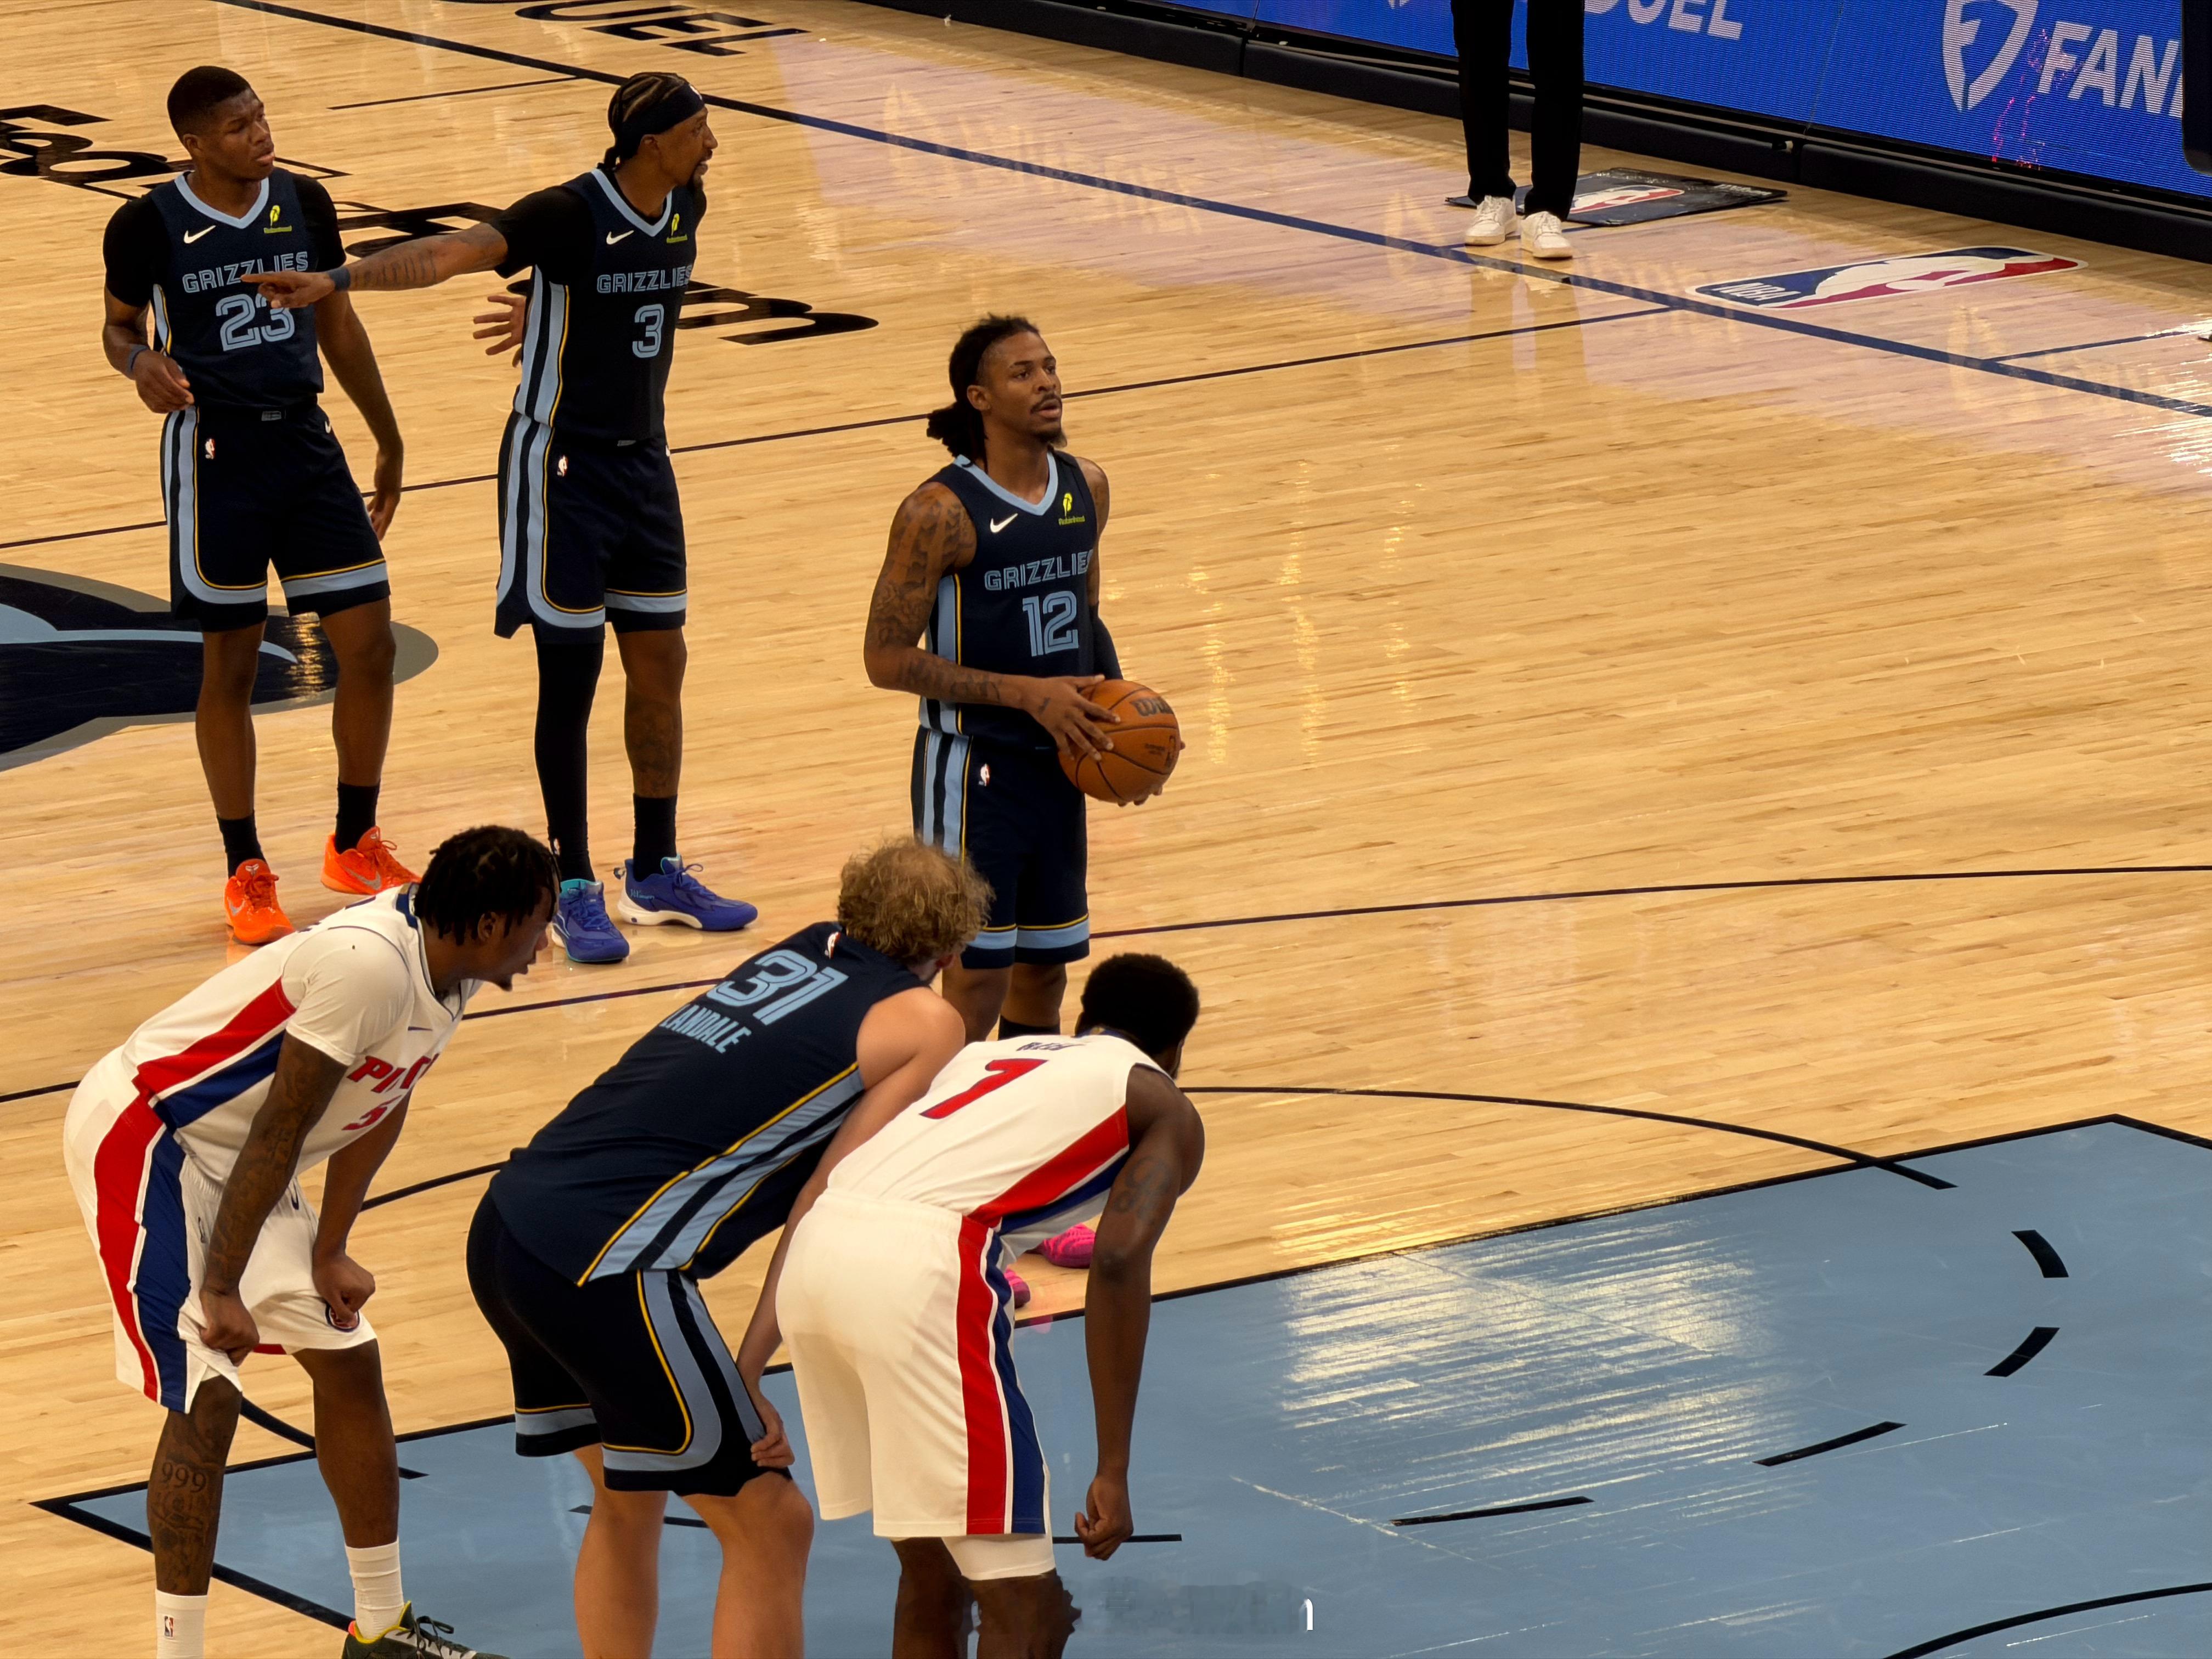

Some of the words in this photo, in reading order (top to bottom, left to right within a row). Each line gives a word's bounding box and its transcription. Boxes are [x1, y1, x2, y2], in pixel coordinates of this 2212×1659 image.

[2037, 21, 2182, 117] FAN
[216, 294, 295, 351] 23
[632, 303, 664, 358] 3
[1022, 590, 1079, 657] 12
[706, 949, 849, 1026] 31
